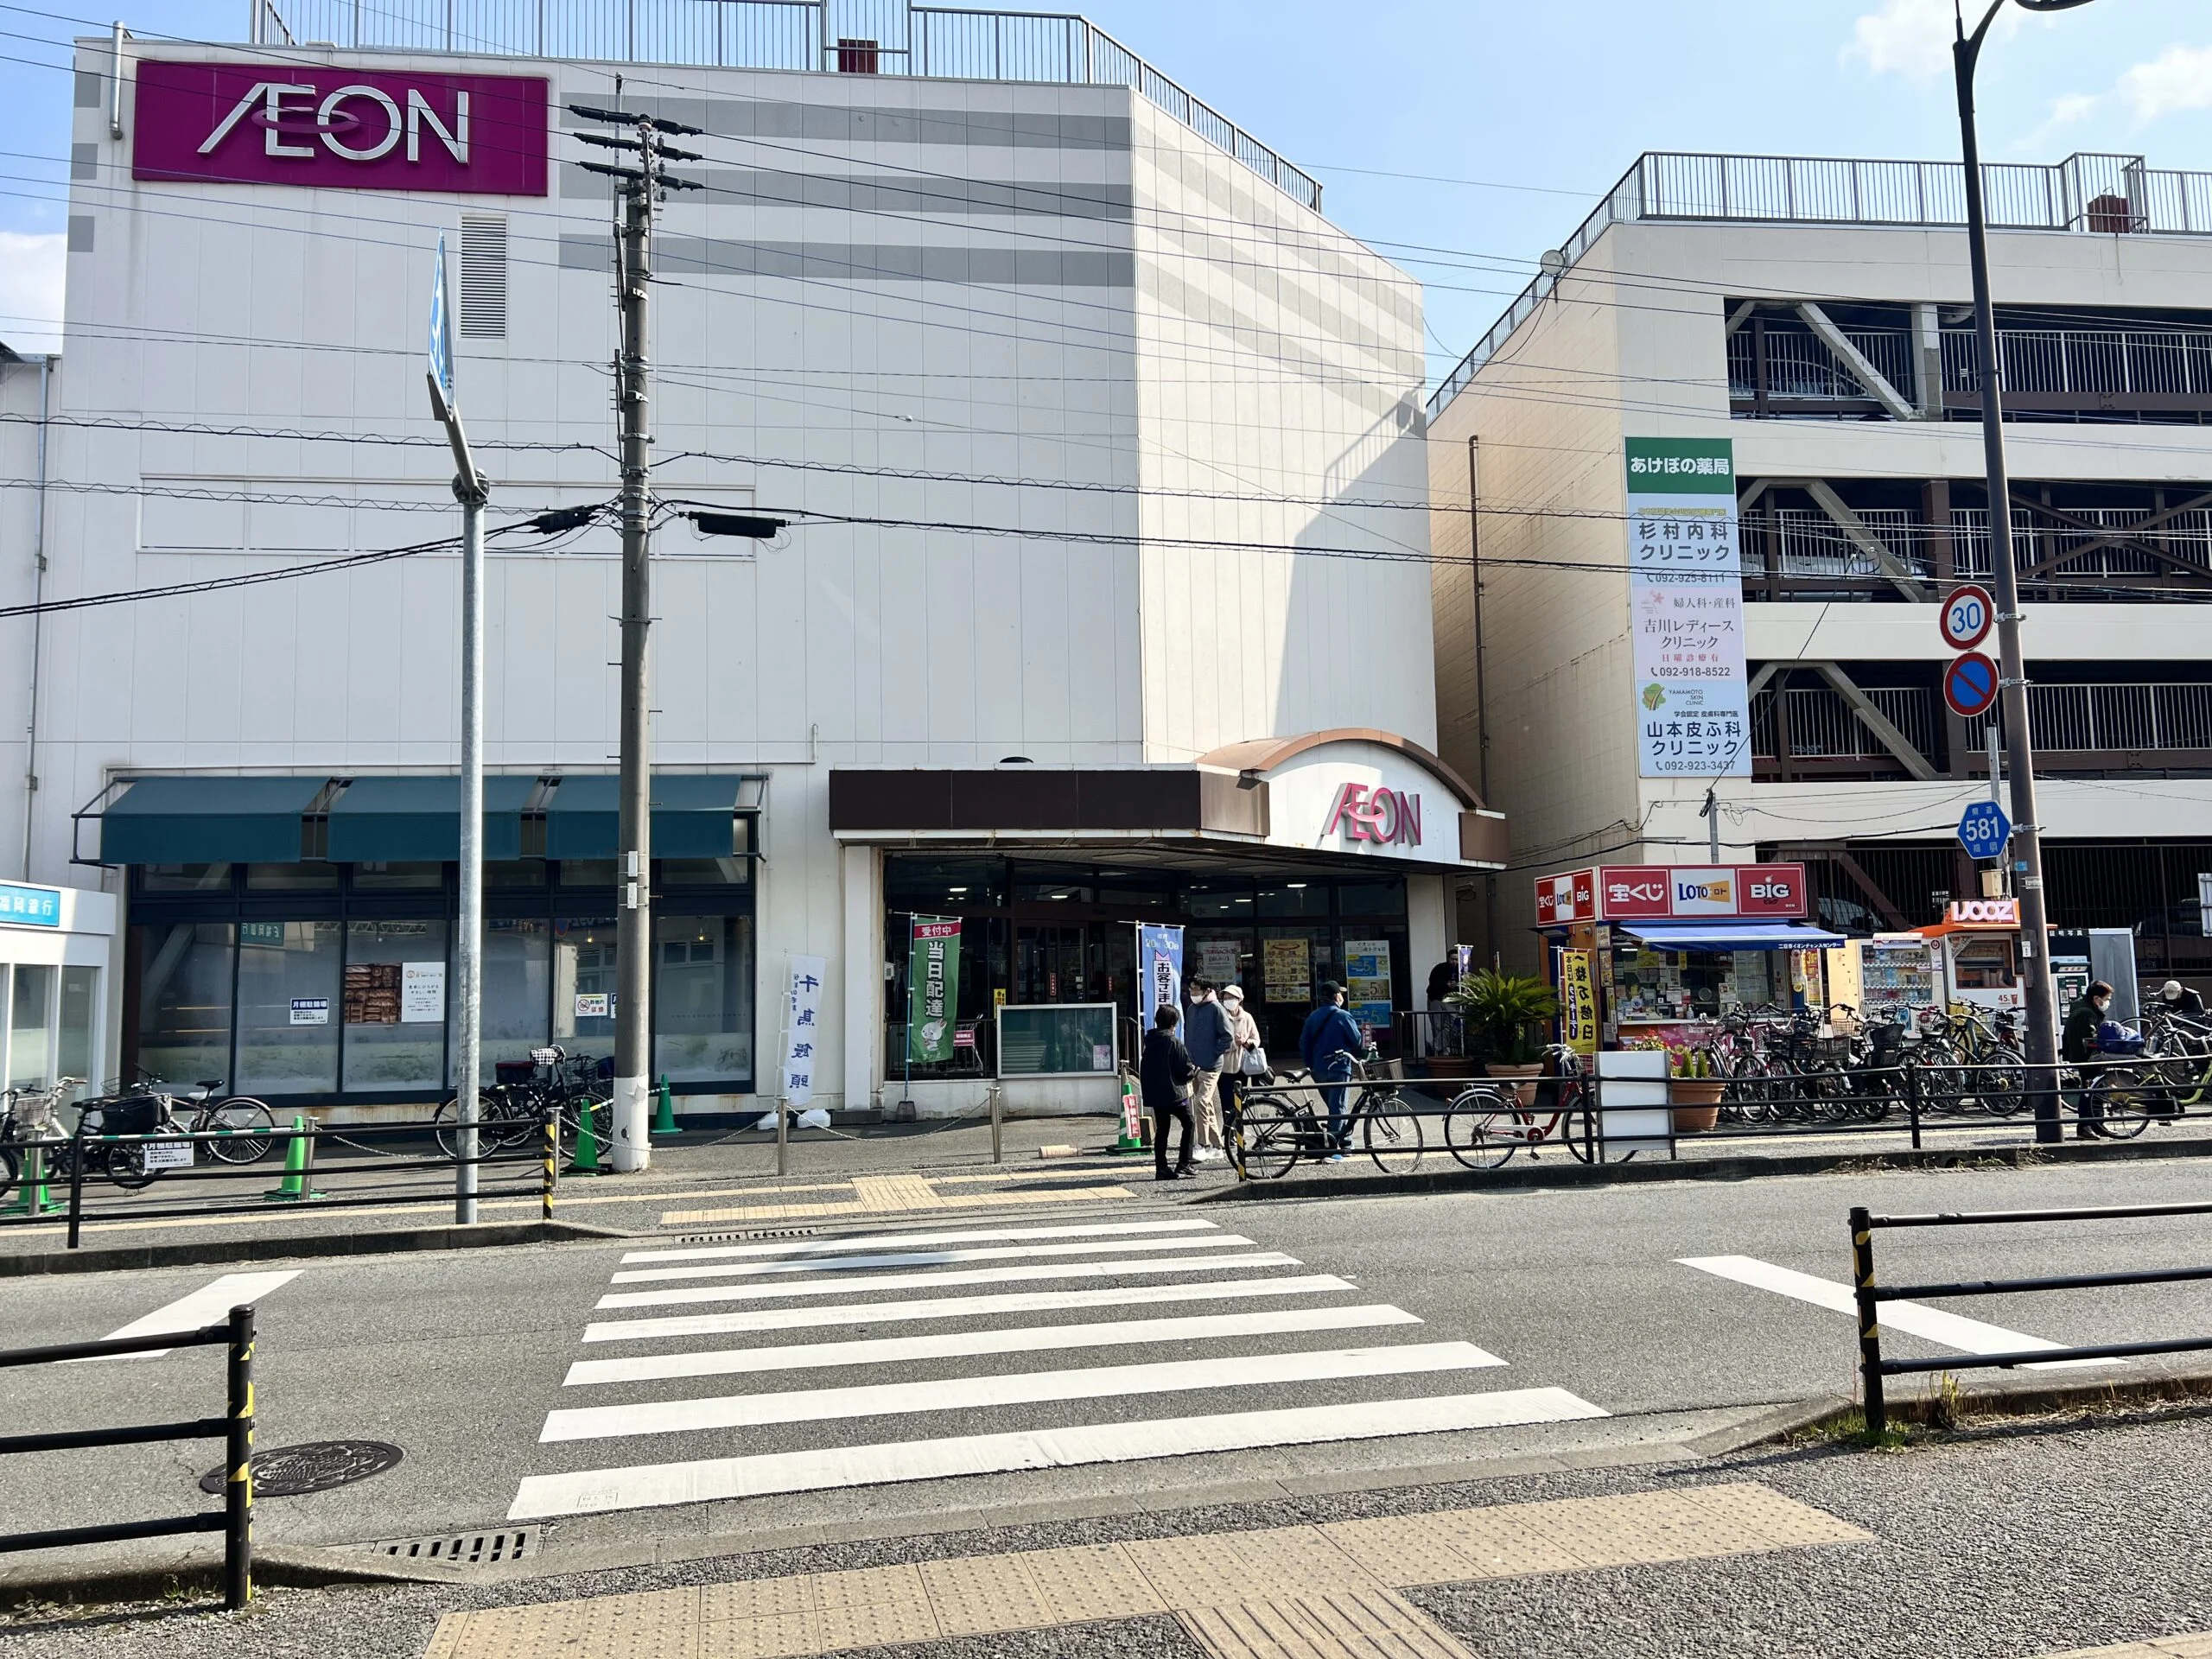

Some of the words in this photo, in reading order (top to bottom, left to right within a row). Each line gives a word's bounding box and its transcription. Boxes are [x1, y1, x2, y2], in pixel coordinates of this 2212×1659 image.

[1630, 457, 1730, 475] あけぼの薬局
[1639, 522, 1728, 540] 杉村内科
[1640, 544, 1730, 561] クリニック
[1674, 597, 1735, 608] 婦人科・産科
[1643, 619, 1734, 633] 吉川レディース
[1952, 602, 1980, 634] 30
[1661, 636, 1719, 650] クリニック
[1660, 667, 1731, 677] 092-918-8522
[1647, 721, 1741, 737] 山本皮ふ科
[1652, 740, 1738, 756] クリニック
[1664, 761, 1735, 771] 092-923-3437
[1966, 817, 1999, 842] 581
[1577, 890, 1590, 902] BIG
[1609, 883, 1664, 902] 宝くじ
[1678, 882, 1708, 900] LOTO
[1750, 883, 1789, 899] BIG
[922, 925, 951, 937] 受付中
[925, 941, 944, 1017] 当日配達
[1157, 963, 1170, 1002] お客さま
